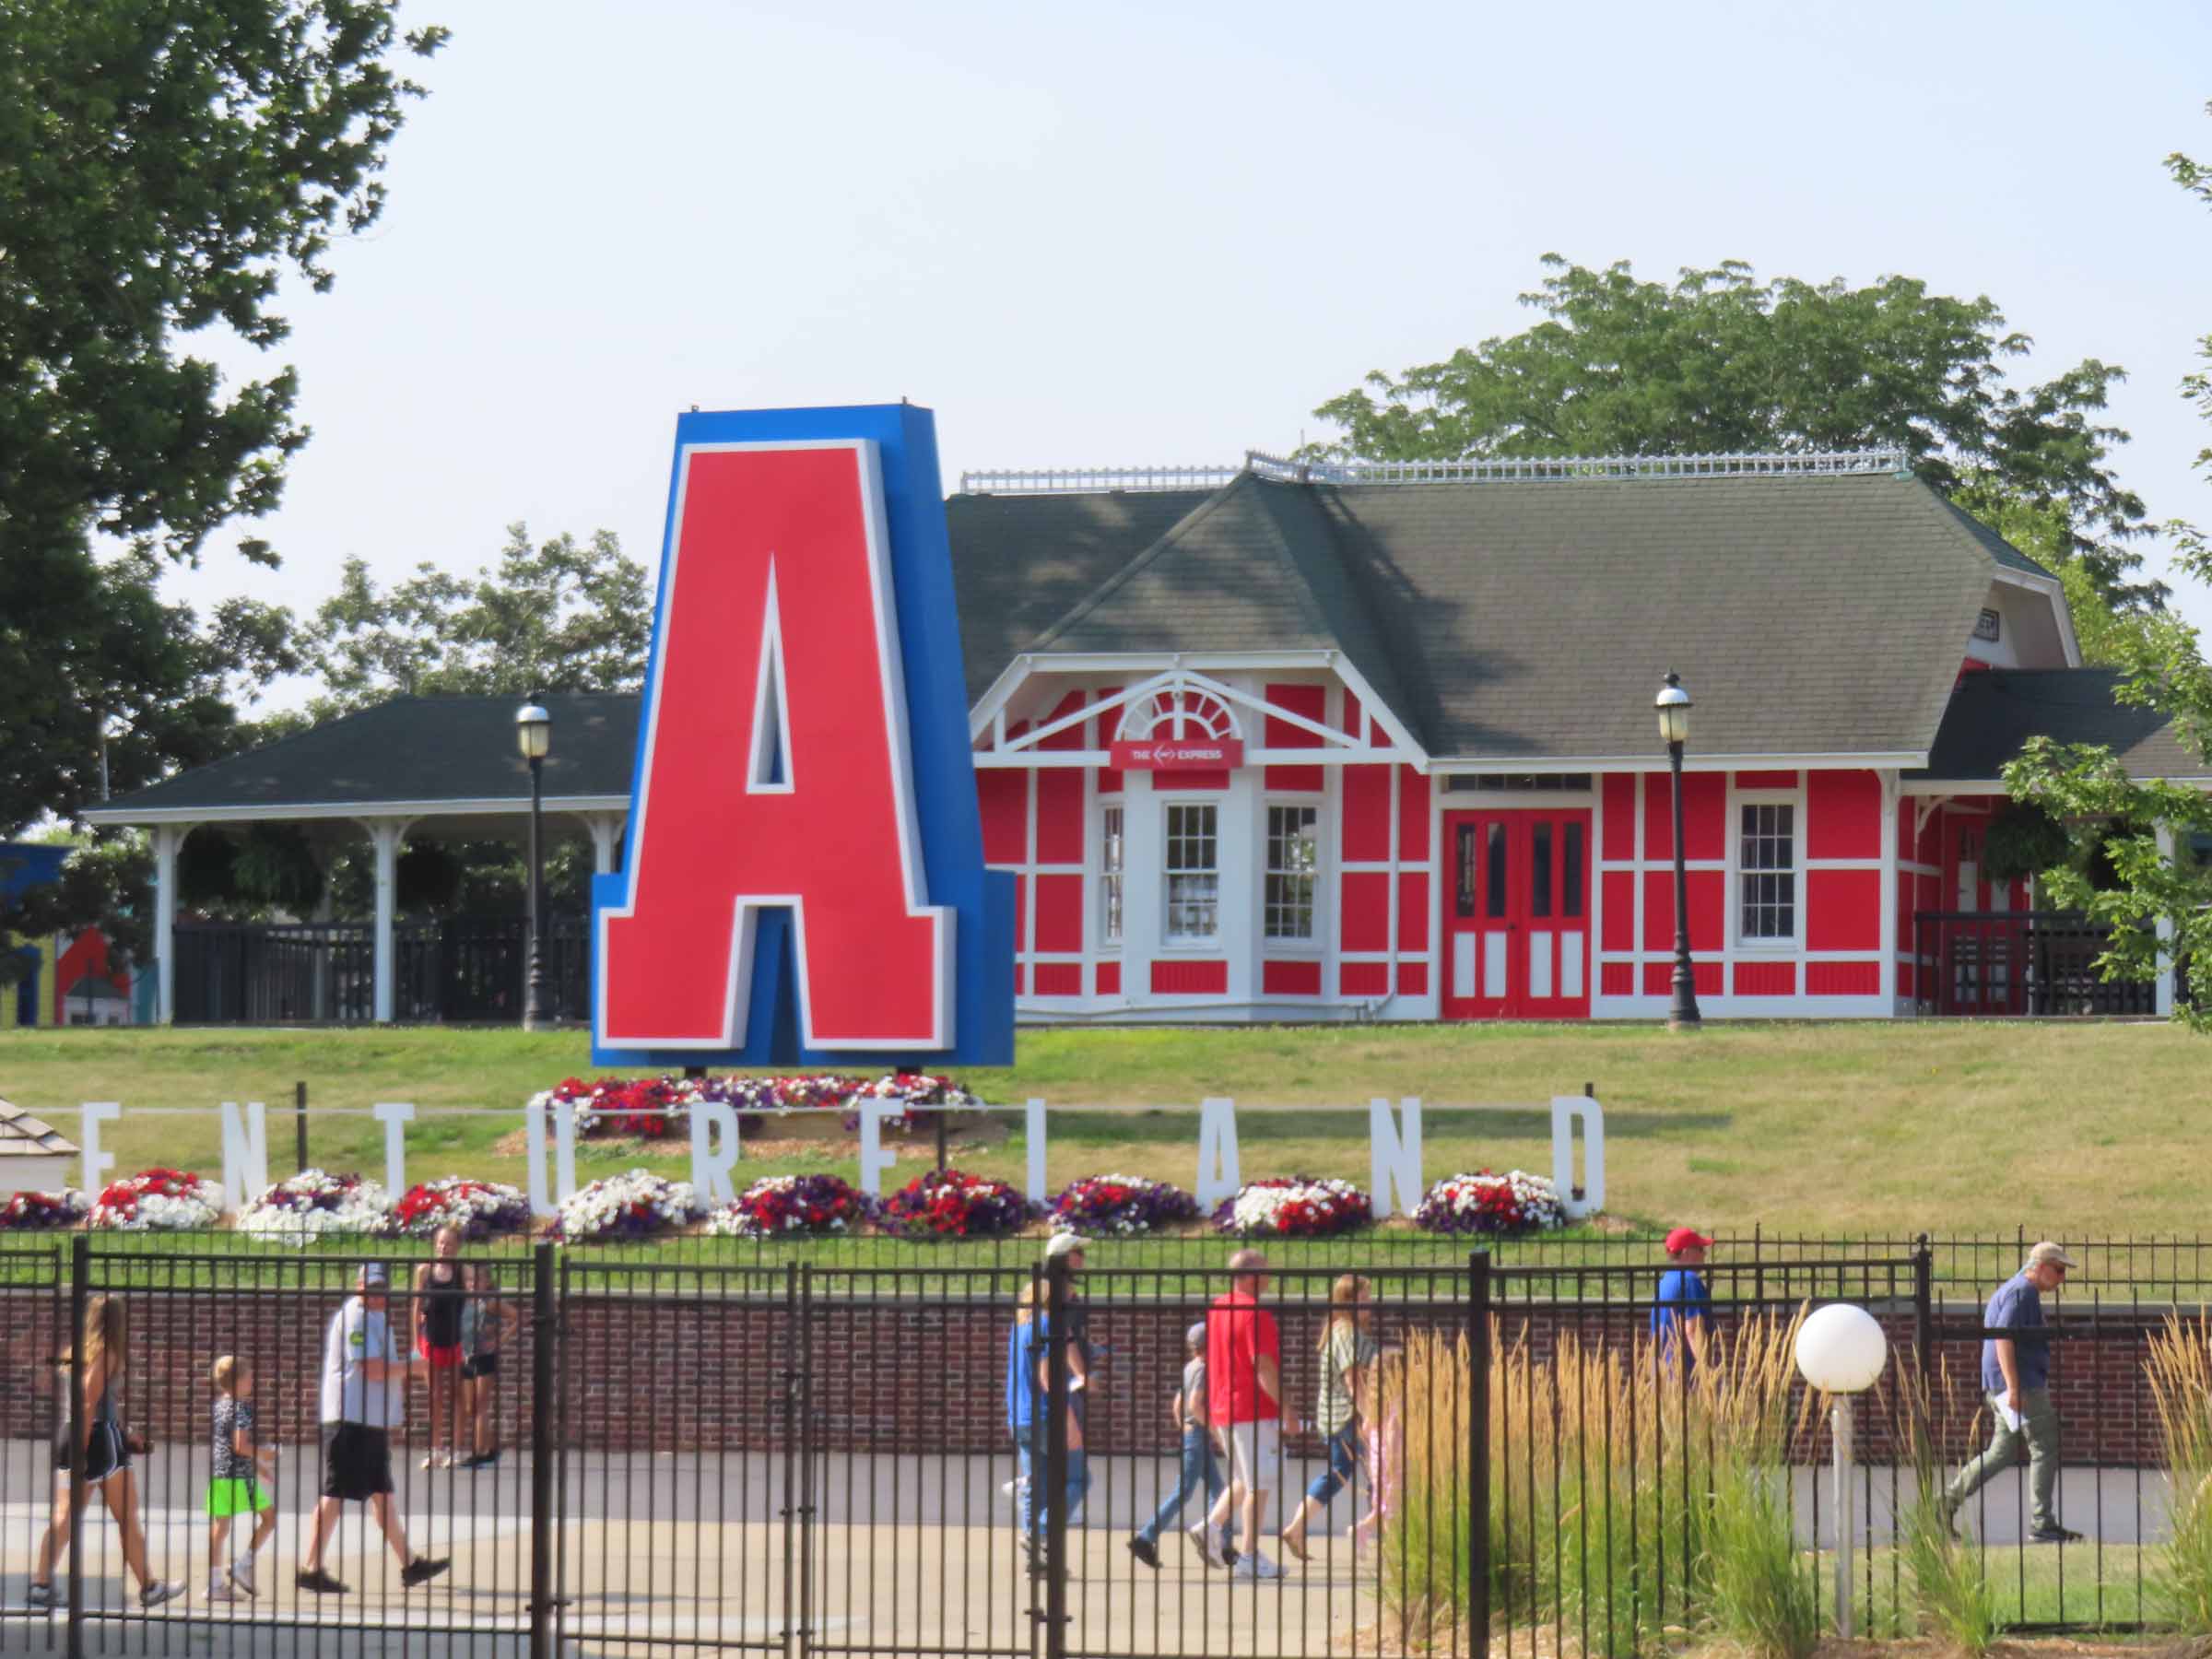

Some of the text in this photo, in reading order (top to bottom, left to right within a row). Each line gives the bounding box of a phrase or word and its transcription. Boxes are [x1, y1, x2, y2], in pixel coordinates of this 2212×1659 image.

[596, 436, 959, 1051] A
[1133, 749, 1151, 760] THE
[1177, 748, 1223, 760] EXPRESS
